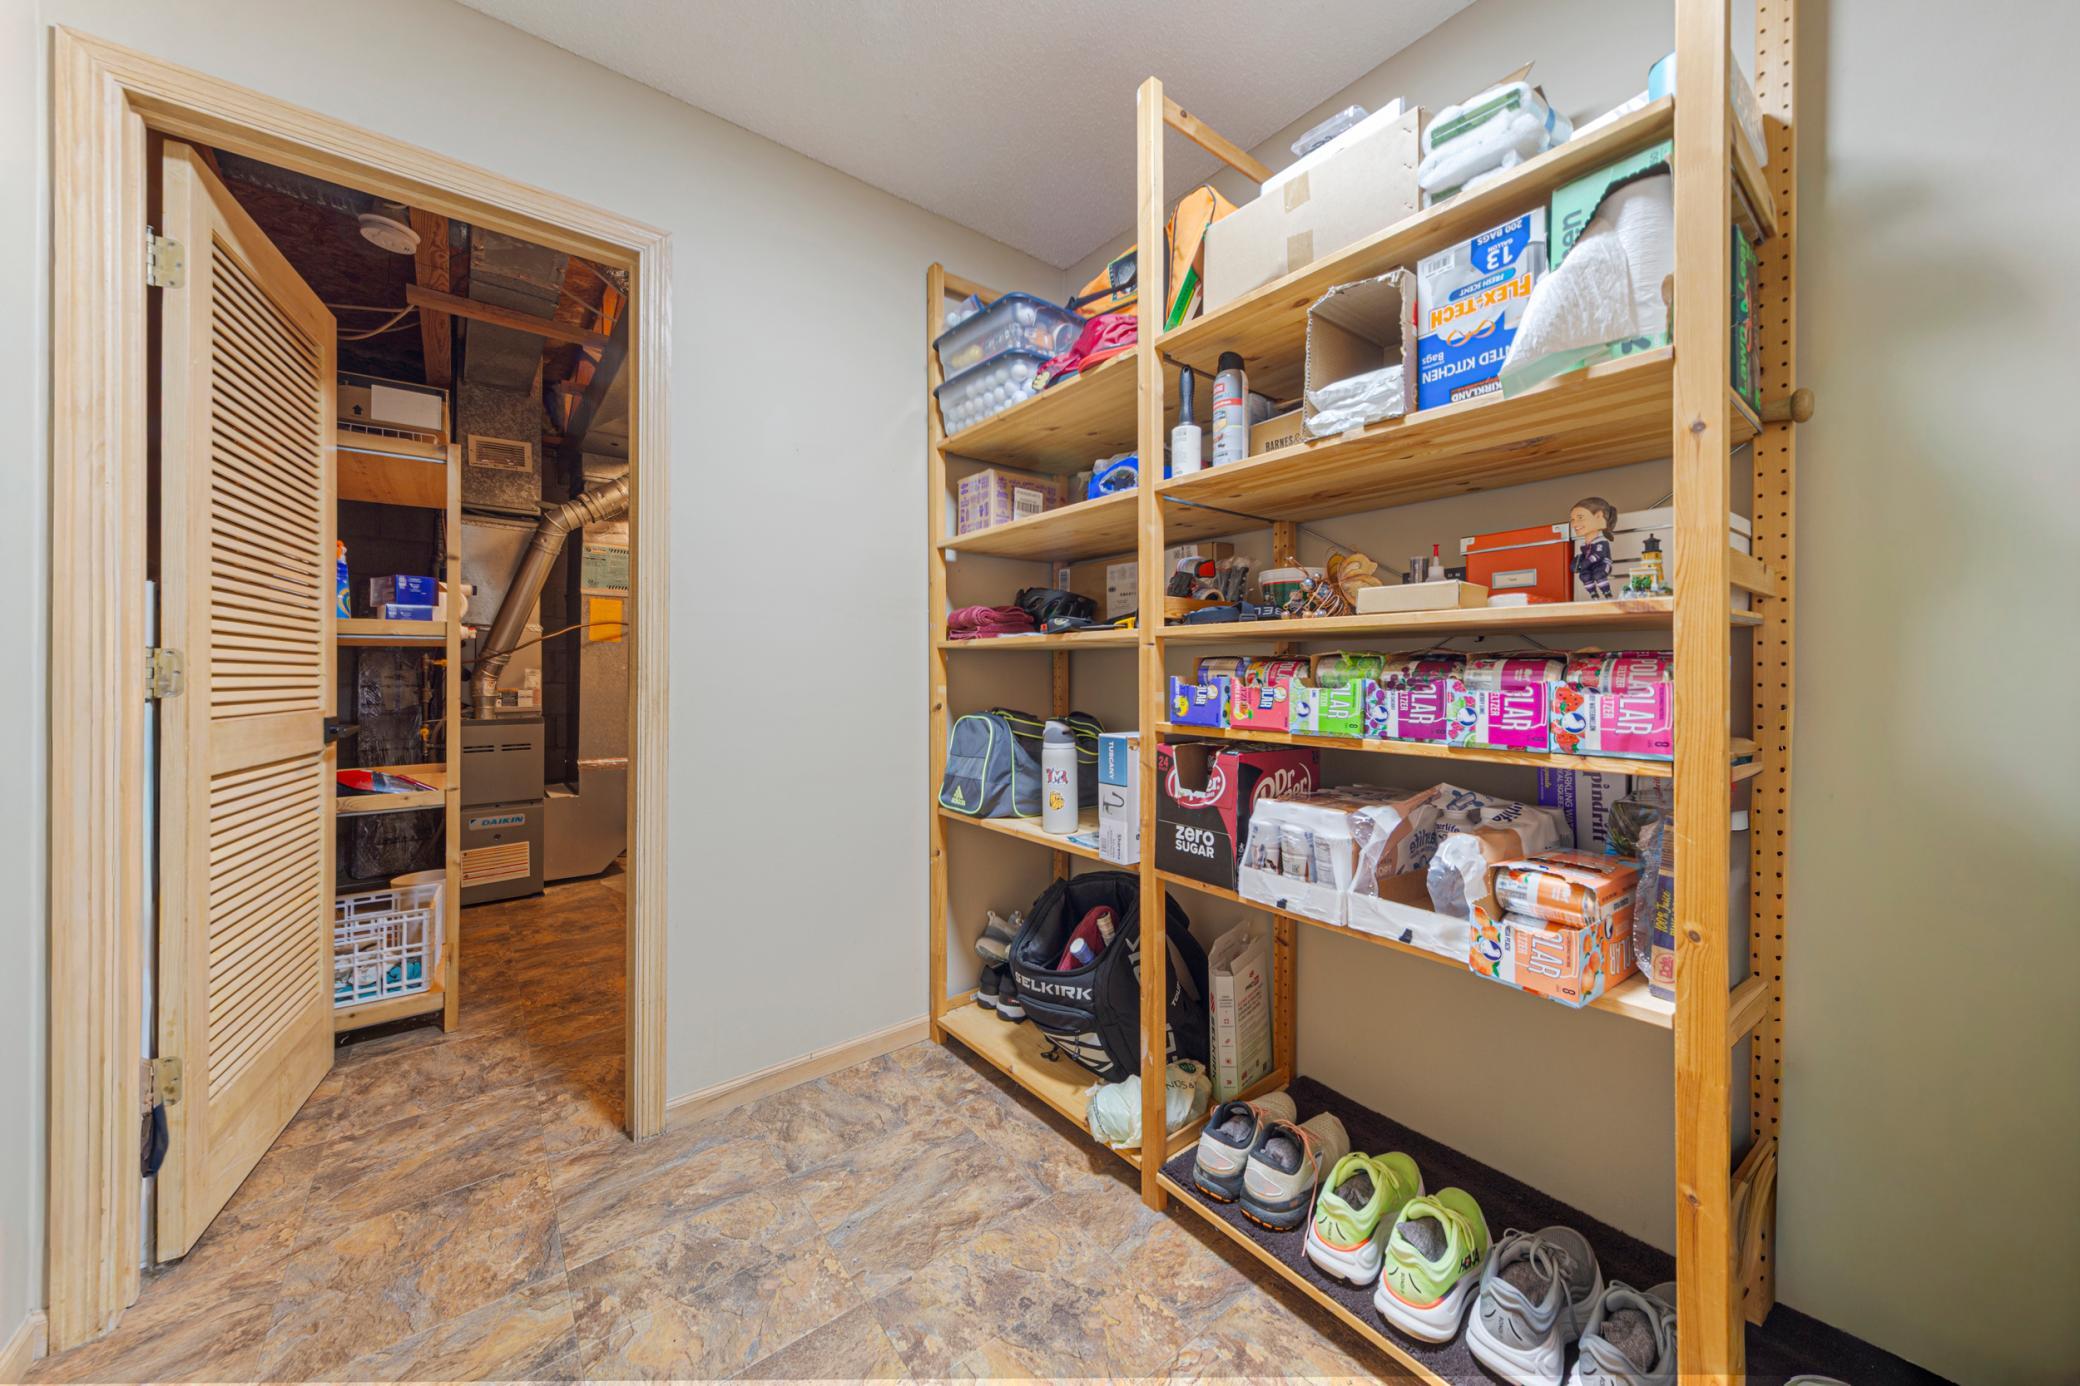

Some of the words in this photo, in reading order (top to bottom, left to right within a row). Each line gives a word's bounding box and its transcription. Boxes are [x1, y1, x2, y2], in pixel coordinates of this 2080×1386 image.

[1476, 226, 1504, 247] BAGS
[1504, 219, 1523, 235] 200
[1487, 237, 1513, 253] GALLON
[1487, 245, 1513, 270] 13
[1459, 280, 1482, 296] SCENT
[1483, 272, 1505, 287] FRESH
[1429, 272, 1532, 330] FLEX-TECH
[1421, 350, 1445, 366] Bags
[1421, 356, 1476, 385] KITCHEN
[1450, 380, 1502, 403] KIRKLAND
[1107, 740, 1115, 780] TUSCANY
[1158, 755, 1169, 768] 24
[1274, 768, 1295, 789] Dr
[481, 816, 523, 826] DAIKIN
[1175, 825, 1215, 847] zero
[1175, 839, 1215, 859] SUGAR
[1014, 971, 1093, 1000] SELKIRK
[1561, 988, 1576, 996] 8
